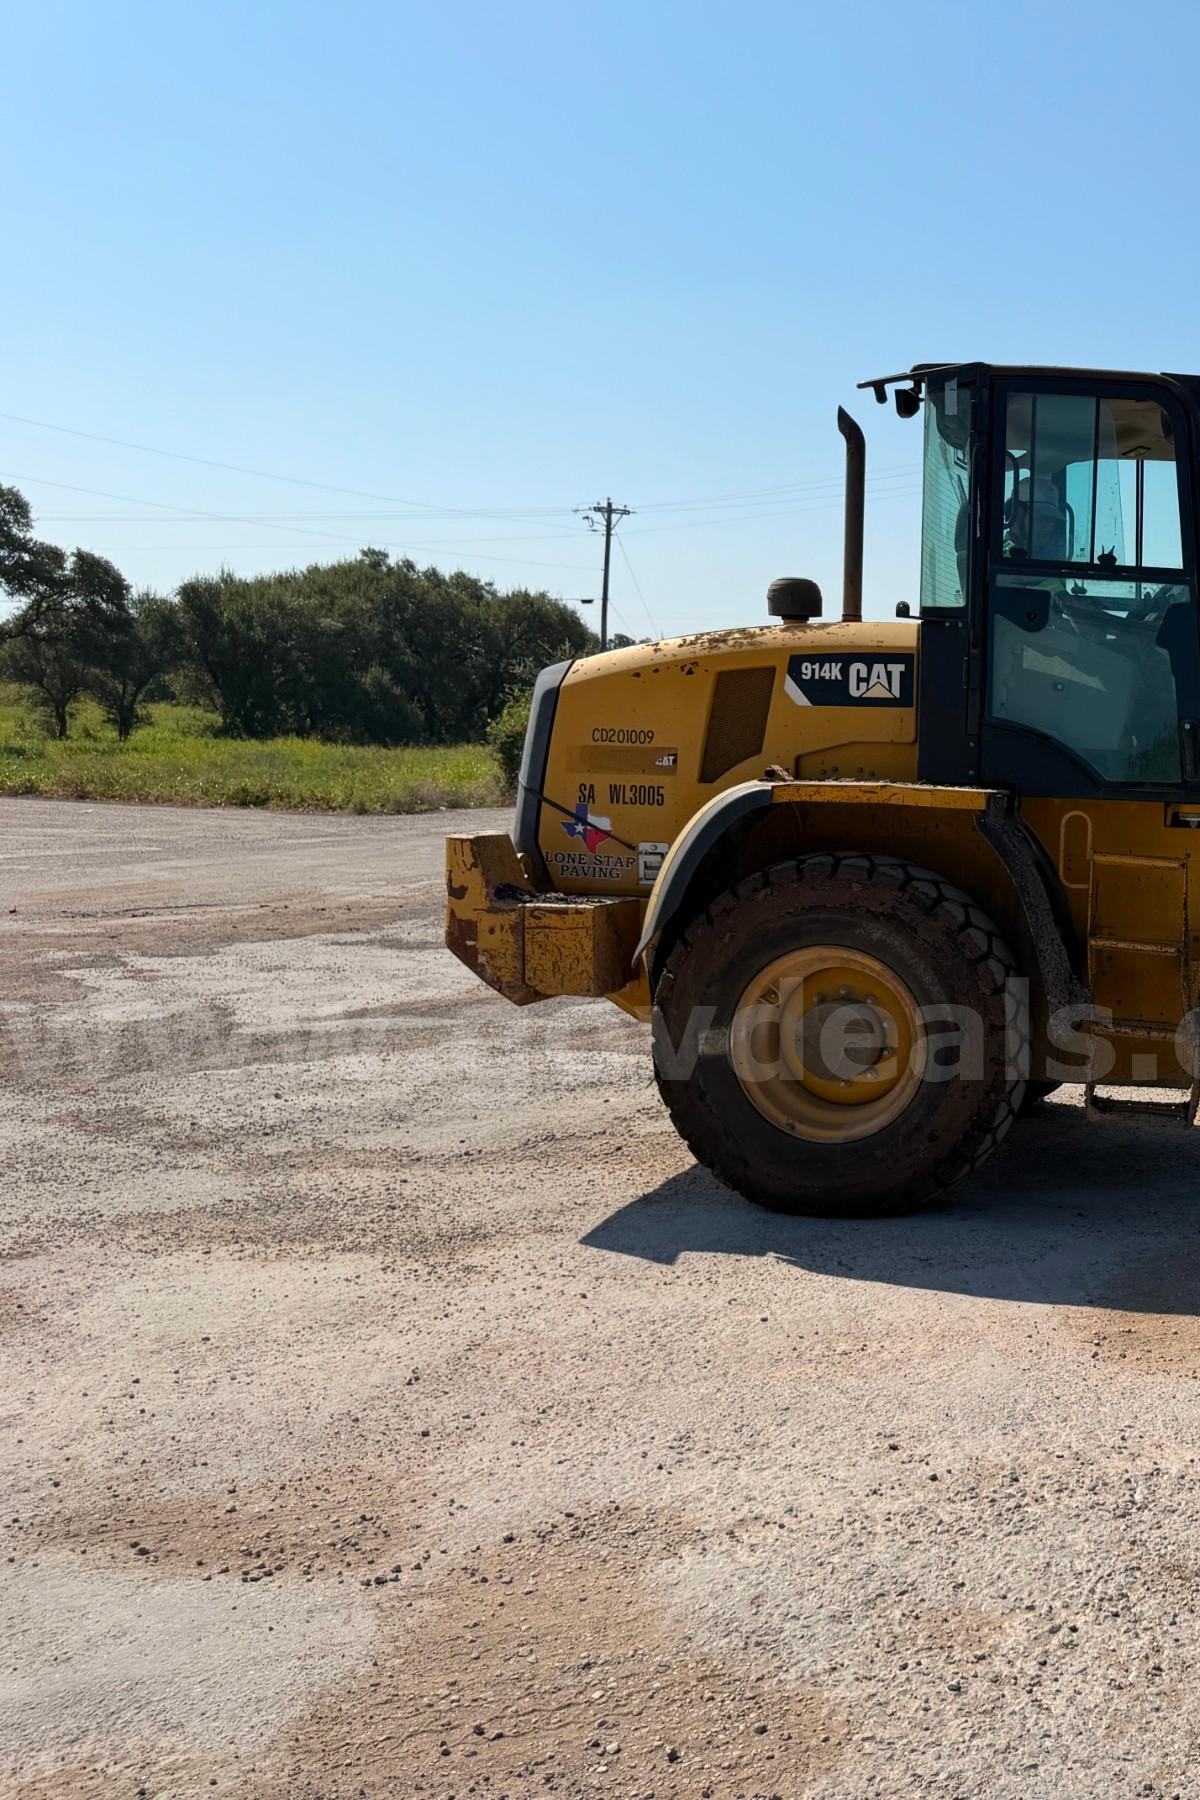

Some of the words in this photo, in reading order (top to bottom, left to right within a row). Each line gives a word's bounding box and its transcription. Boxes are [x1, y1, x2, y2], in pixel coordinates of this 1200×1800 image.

[801, 662, 843, 681] 914K
[848, 662, 906, 699] CAT
[592, 728, 655, 744] CD201009
[578, 783, 596, 804] SA
[609, 784, 665, 806] WL3005
[545, 851, 588, 865] LONE
[560, 865, 620, 879] PAVING
